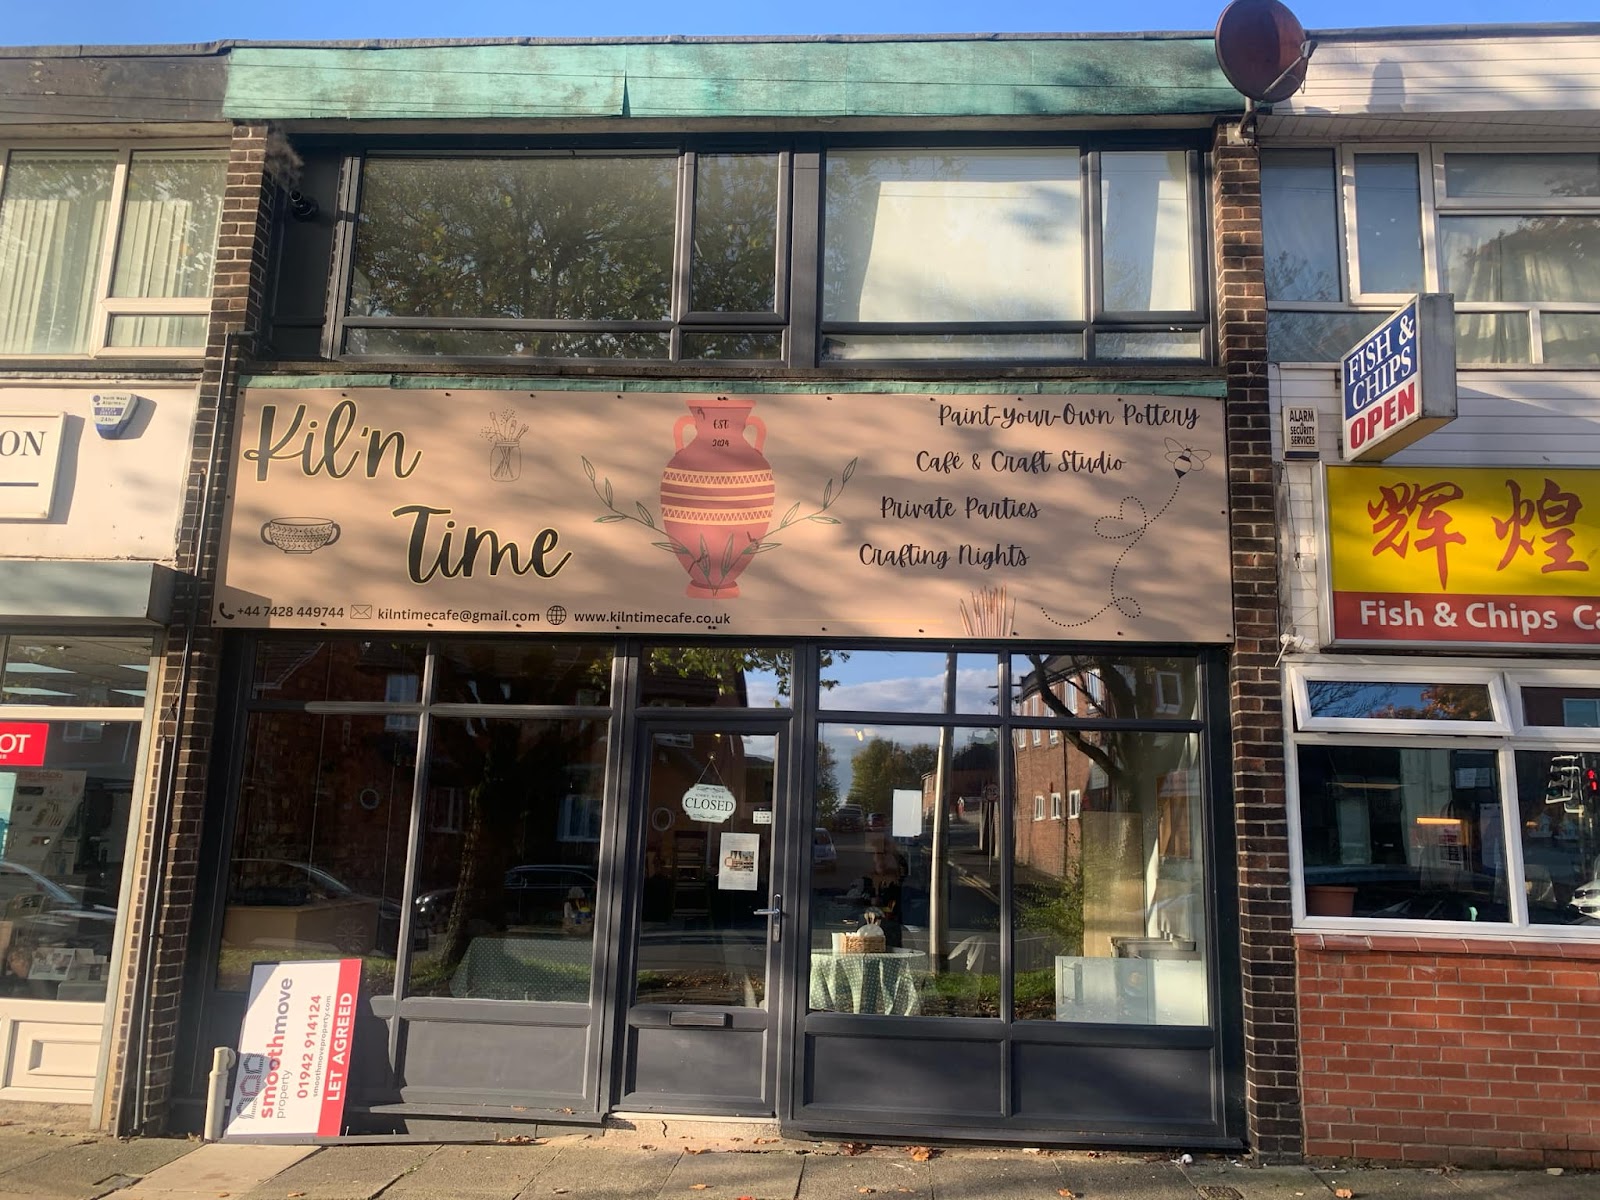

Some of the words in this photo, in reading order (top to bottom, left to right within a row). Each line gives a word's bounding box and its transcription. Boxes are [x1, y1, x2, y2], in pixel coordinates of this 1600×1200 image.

[1348, 327, 1393, 386] FISH
[1398, 315, 1415, 346] &
[1352, 346, 1411, 410] CHIPS
[713, 419, 730, 430] EST
[1122, 403, 1200, 430] Pottery
[1289, 410, 1315, 423] ALARM
[1290, 426, 1315, 436] SECURITY
[1350, 382, 1415, 450] OPEN
[1290, 435, 1316, 445] SERVICES
[972, 453, 981, 469] &
[991, 449, 1050, 475] Craft
[1057, 450, 1127, 474] Studio
[880, 495, 957, 519] Private
[964, 496, 1041, 520] Parties
[392, 504, 574, 585] Time
[859, 543, 950, 570] Crafting
[958, 544, 1030, 570] Nights
[237, 606, 260, 617] +44
[263, 607, 293, 617] 7428
[296, 607, 345, 618] 449744
[377, 608, 541, 623] kilntimecafe@gmail.com
[573, 611, 732, 625] www.kilntimecafe.co.uk
[1360, 600, 1424, 627] Fish
[1433, 601, 1459, 628] &
[1465, 602, 1558, 636] Chips
[684, 797, 734, 812] CLOSED
[304, 994, 323, 1048] 914124
[332, 993, 353, 1065] AGREED
[261, 977, 294, 1119] smoothmove
[313, 995, 332, 1098] smoothmoveproperty.com
[297, 1053, 315, 1099] 01942
[327, 1070, 343, 1101] LET
[277, 1070, 293, 1119] property
